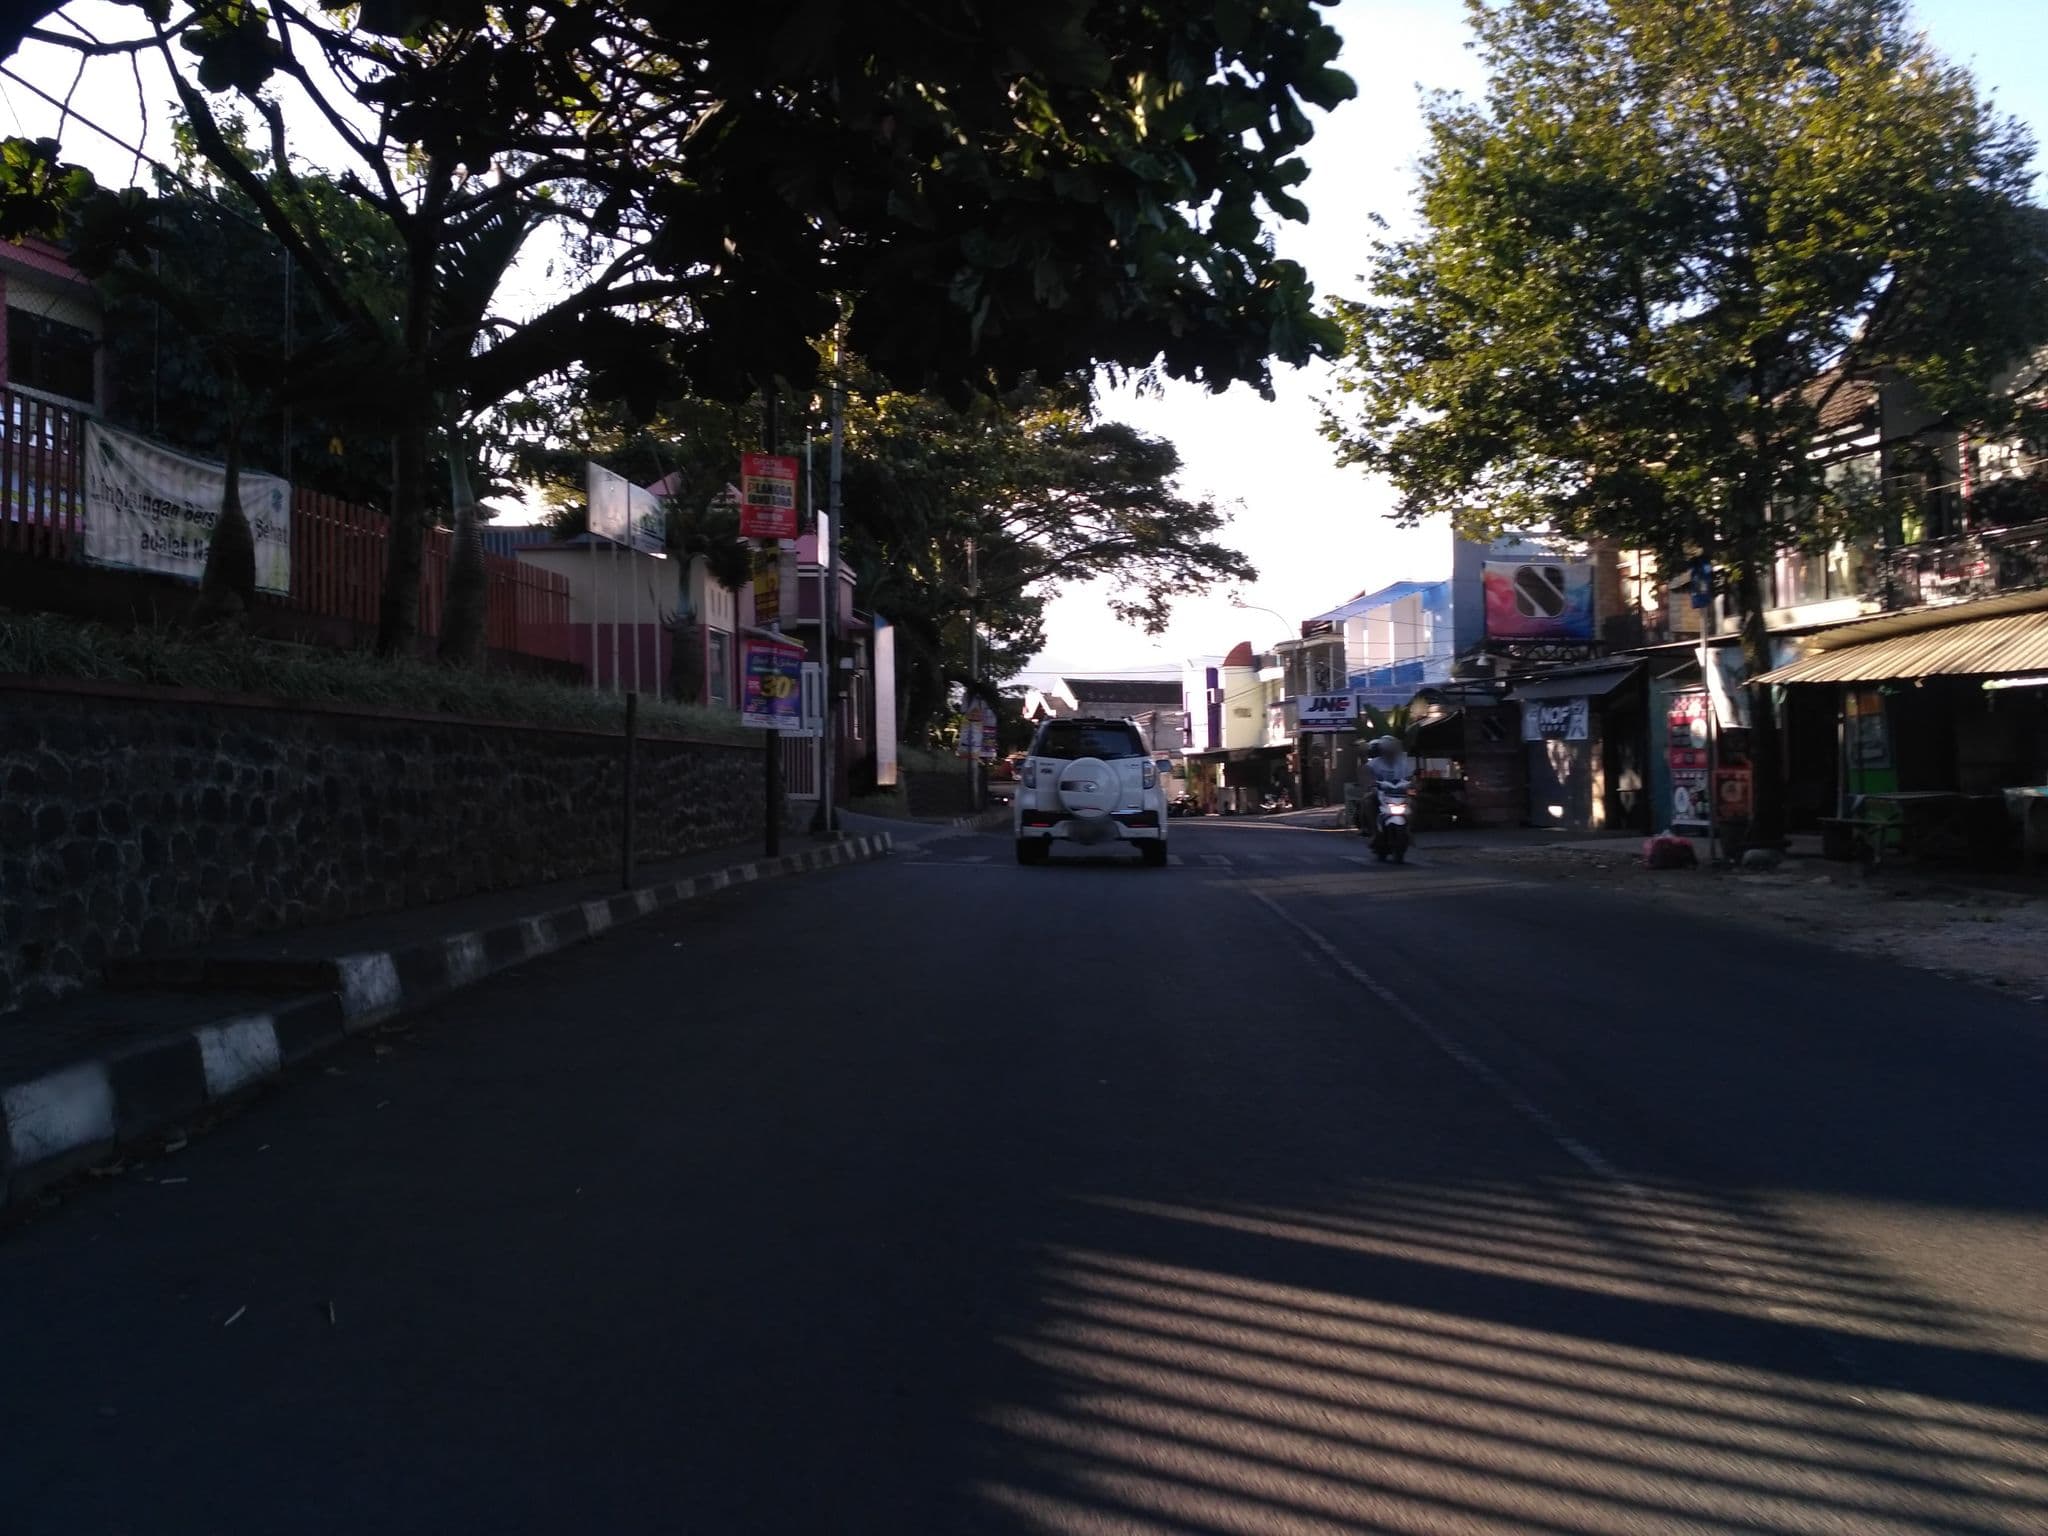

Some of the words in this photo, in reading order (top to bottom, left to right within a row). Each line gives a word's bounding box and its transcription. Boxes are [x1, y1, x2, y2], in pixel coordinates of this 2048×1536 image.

[91, 474, 181, 524] Lingkungan
[140, 528, 188, 557] adalah
[1304, 697, 1350, 712] JNE
